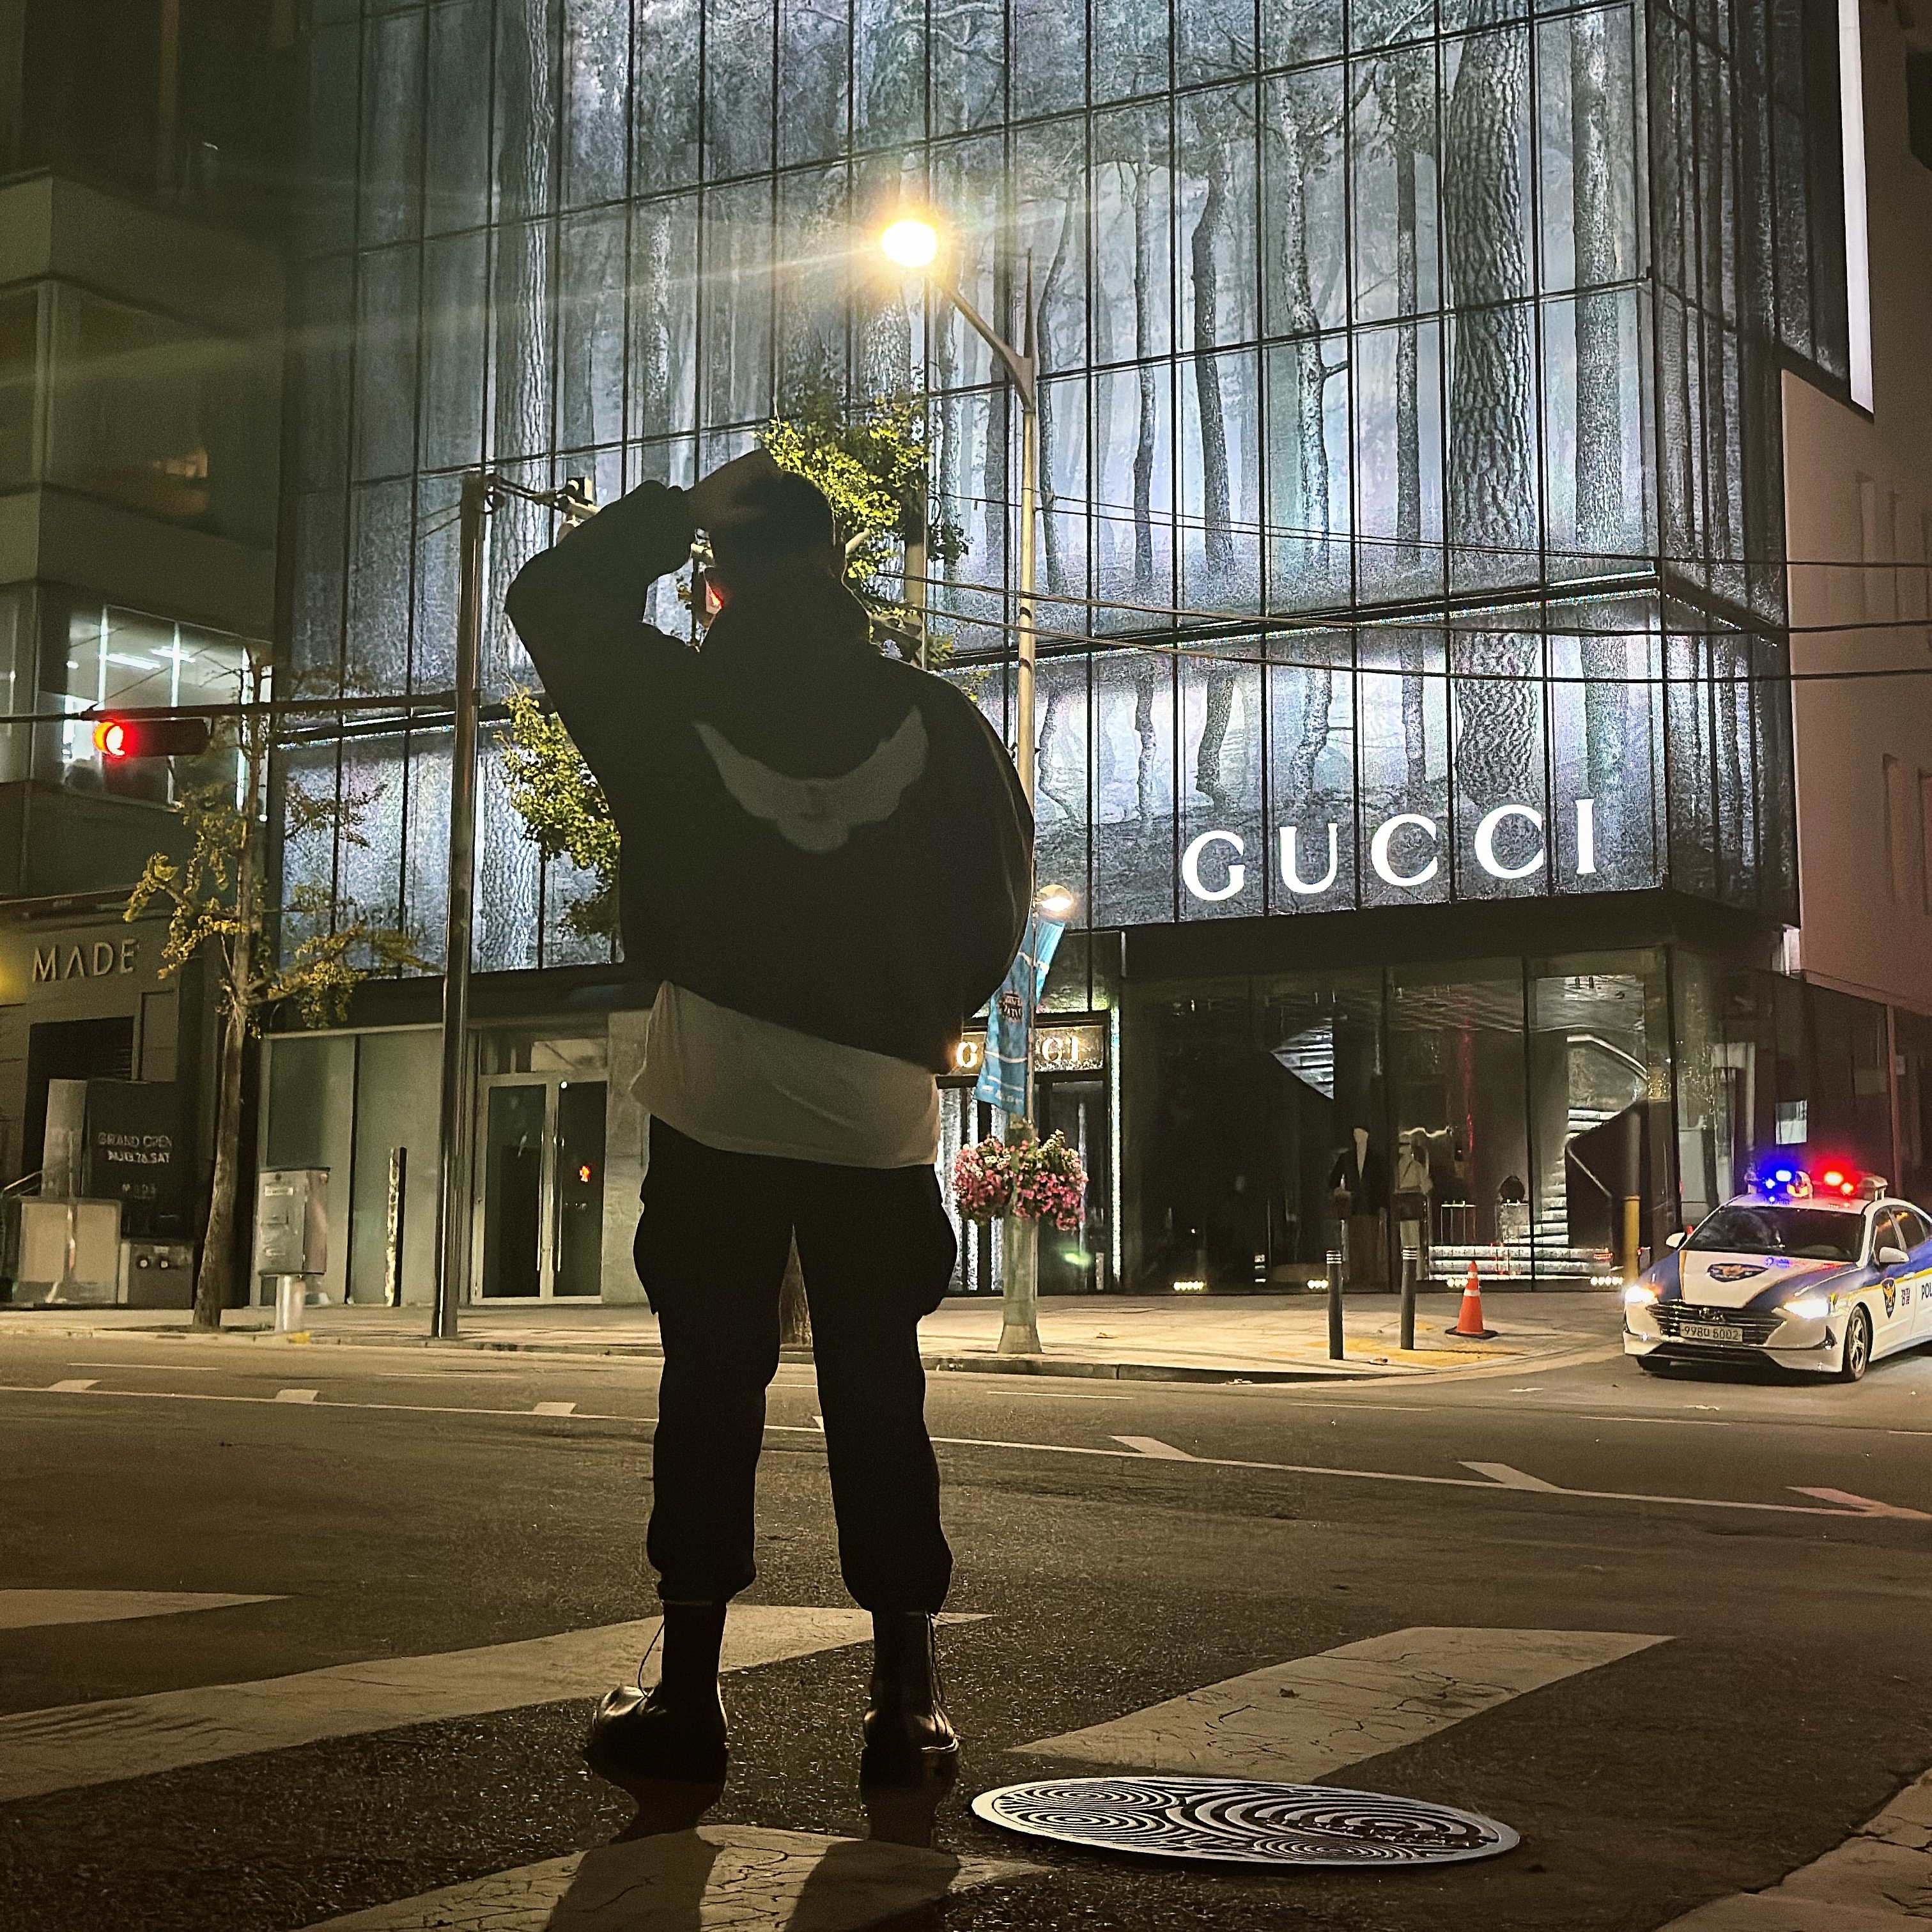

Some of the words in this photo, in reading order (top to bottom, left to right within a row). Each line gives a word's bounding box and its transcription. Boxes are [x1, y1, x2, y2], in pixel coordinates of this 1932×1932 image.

[1182, 798, 1596, 901] GUCCI
[33, 938, 136, 982] MADE
[956, 1035, 1080, 1068] GCI
